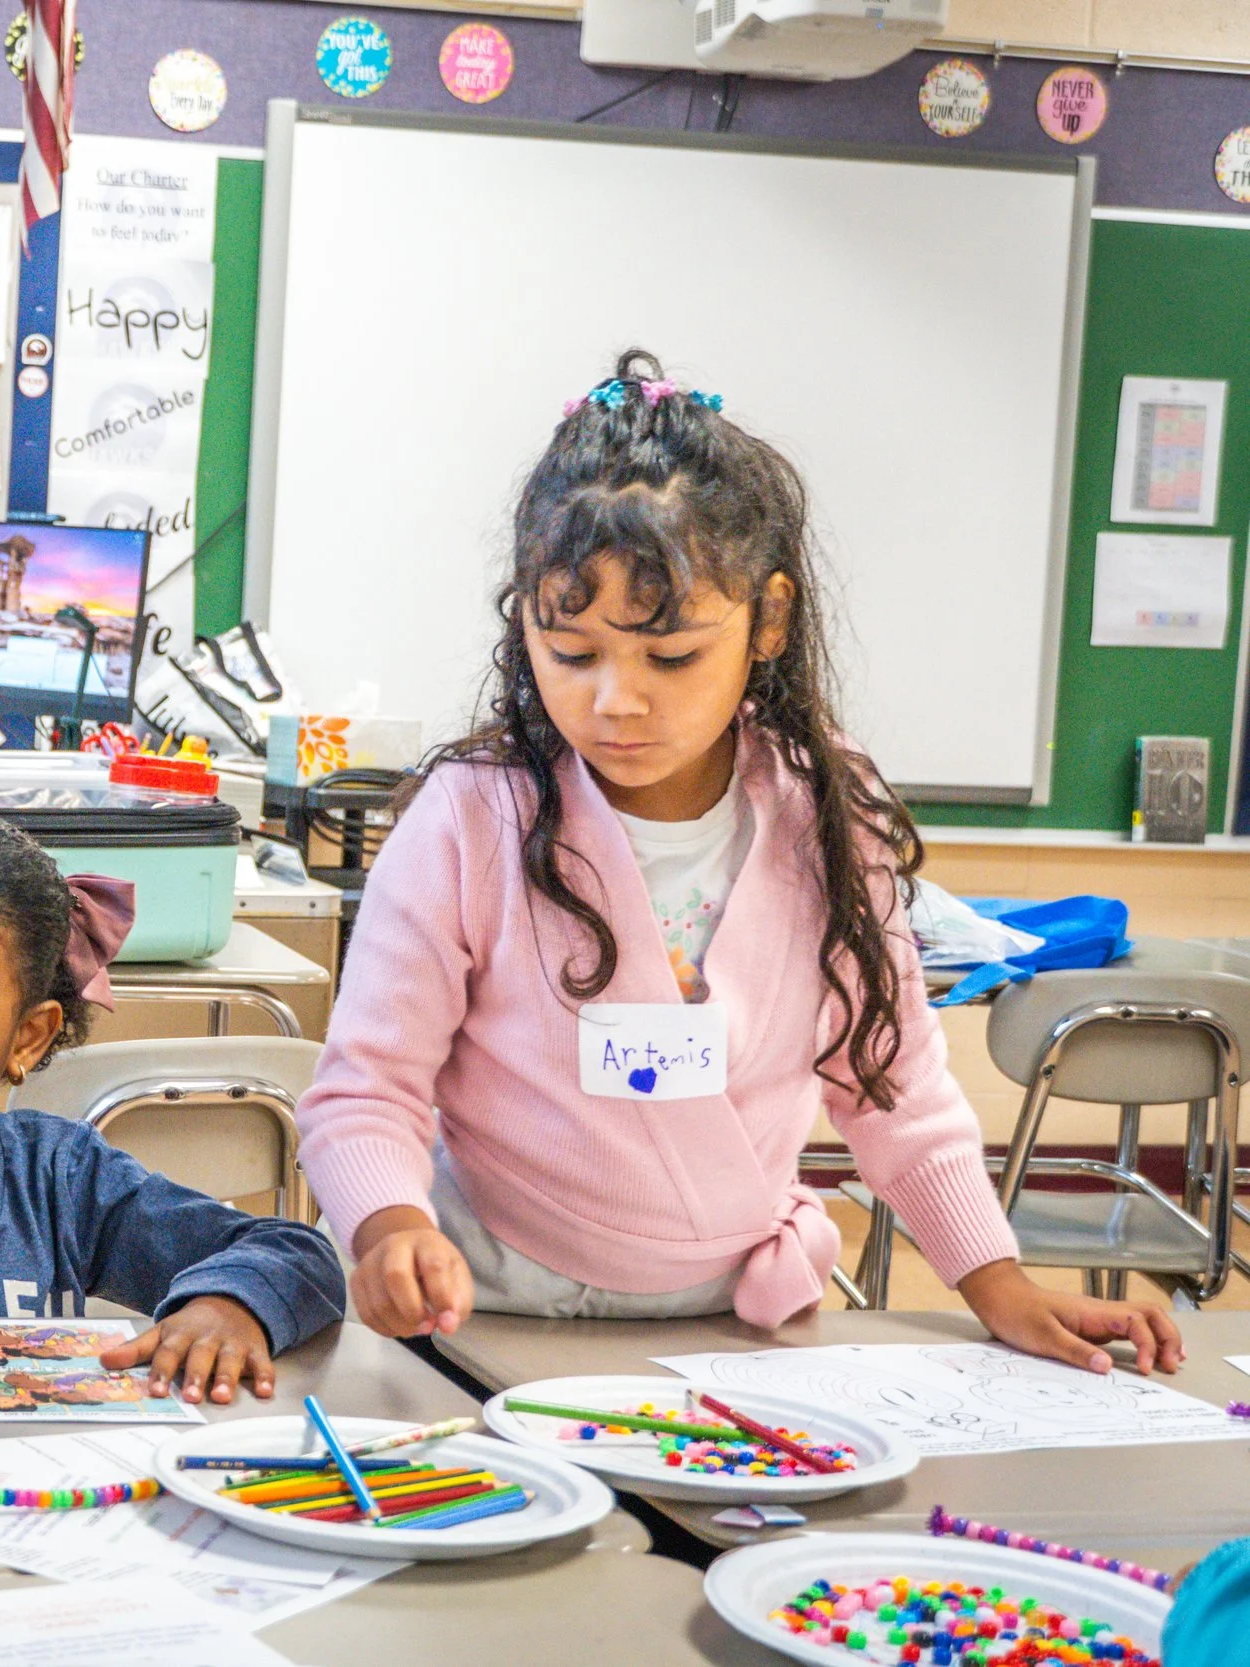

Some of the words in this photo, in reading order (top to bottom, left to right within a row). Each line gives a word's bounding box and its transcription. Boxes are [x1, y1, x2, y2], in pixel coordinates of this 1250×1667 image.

[327, 32, 380, 50] YOU'VE
[460, 37, 494, 56] MAKE
[336, 46, 363, 76] got
[348, 65, 379, 82] THIS
[455, 71, 494, 89] GREAT
[934, 76, 979, 98] Believe
[1052, 79, 1094, 99] NEVER
[929, 104, 976, 122] YOURSELF
[1052, 100, 1087, 120] give
[1062, 113, 1081, 137] up
[97, 168, 126, 185] Our
[131, 170, 189, 190] Charter
[77, 198, 111, 212] How
[116, 200, 135, 214] do
[138, 204, 167, 219] you
[171, 205, 206, 218] want
[92, 226, 107, 237] to
[110, 225, 136, 240] feel
[68, 287, 208, 360] Happy
[54, 389, 195, 459] Comfortable
[603, 1038, 711, 1071] Artemis
